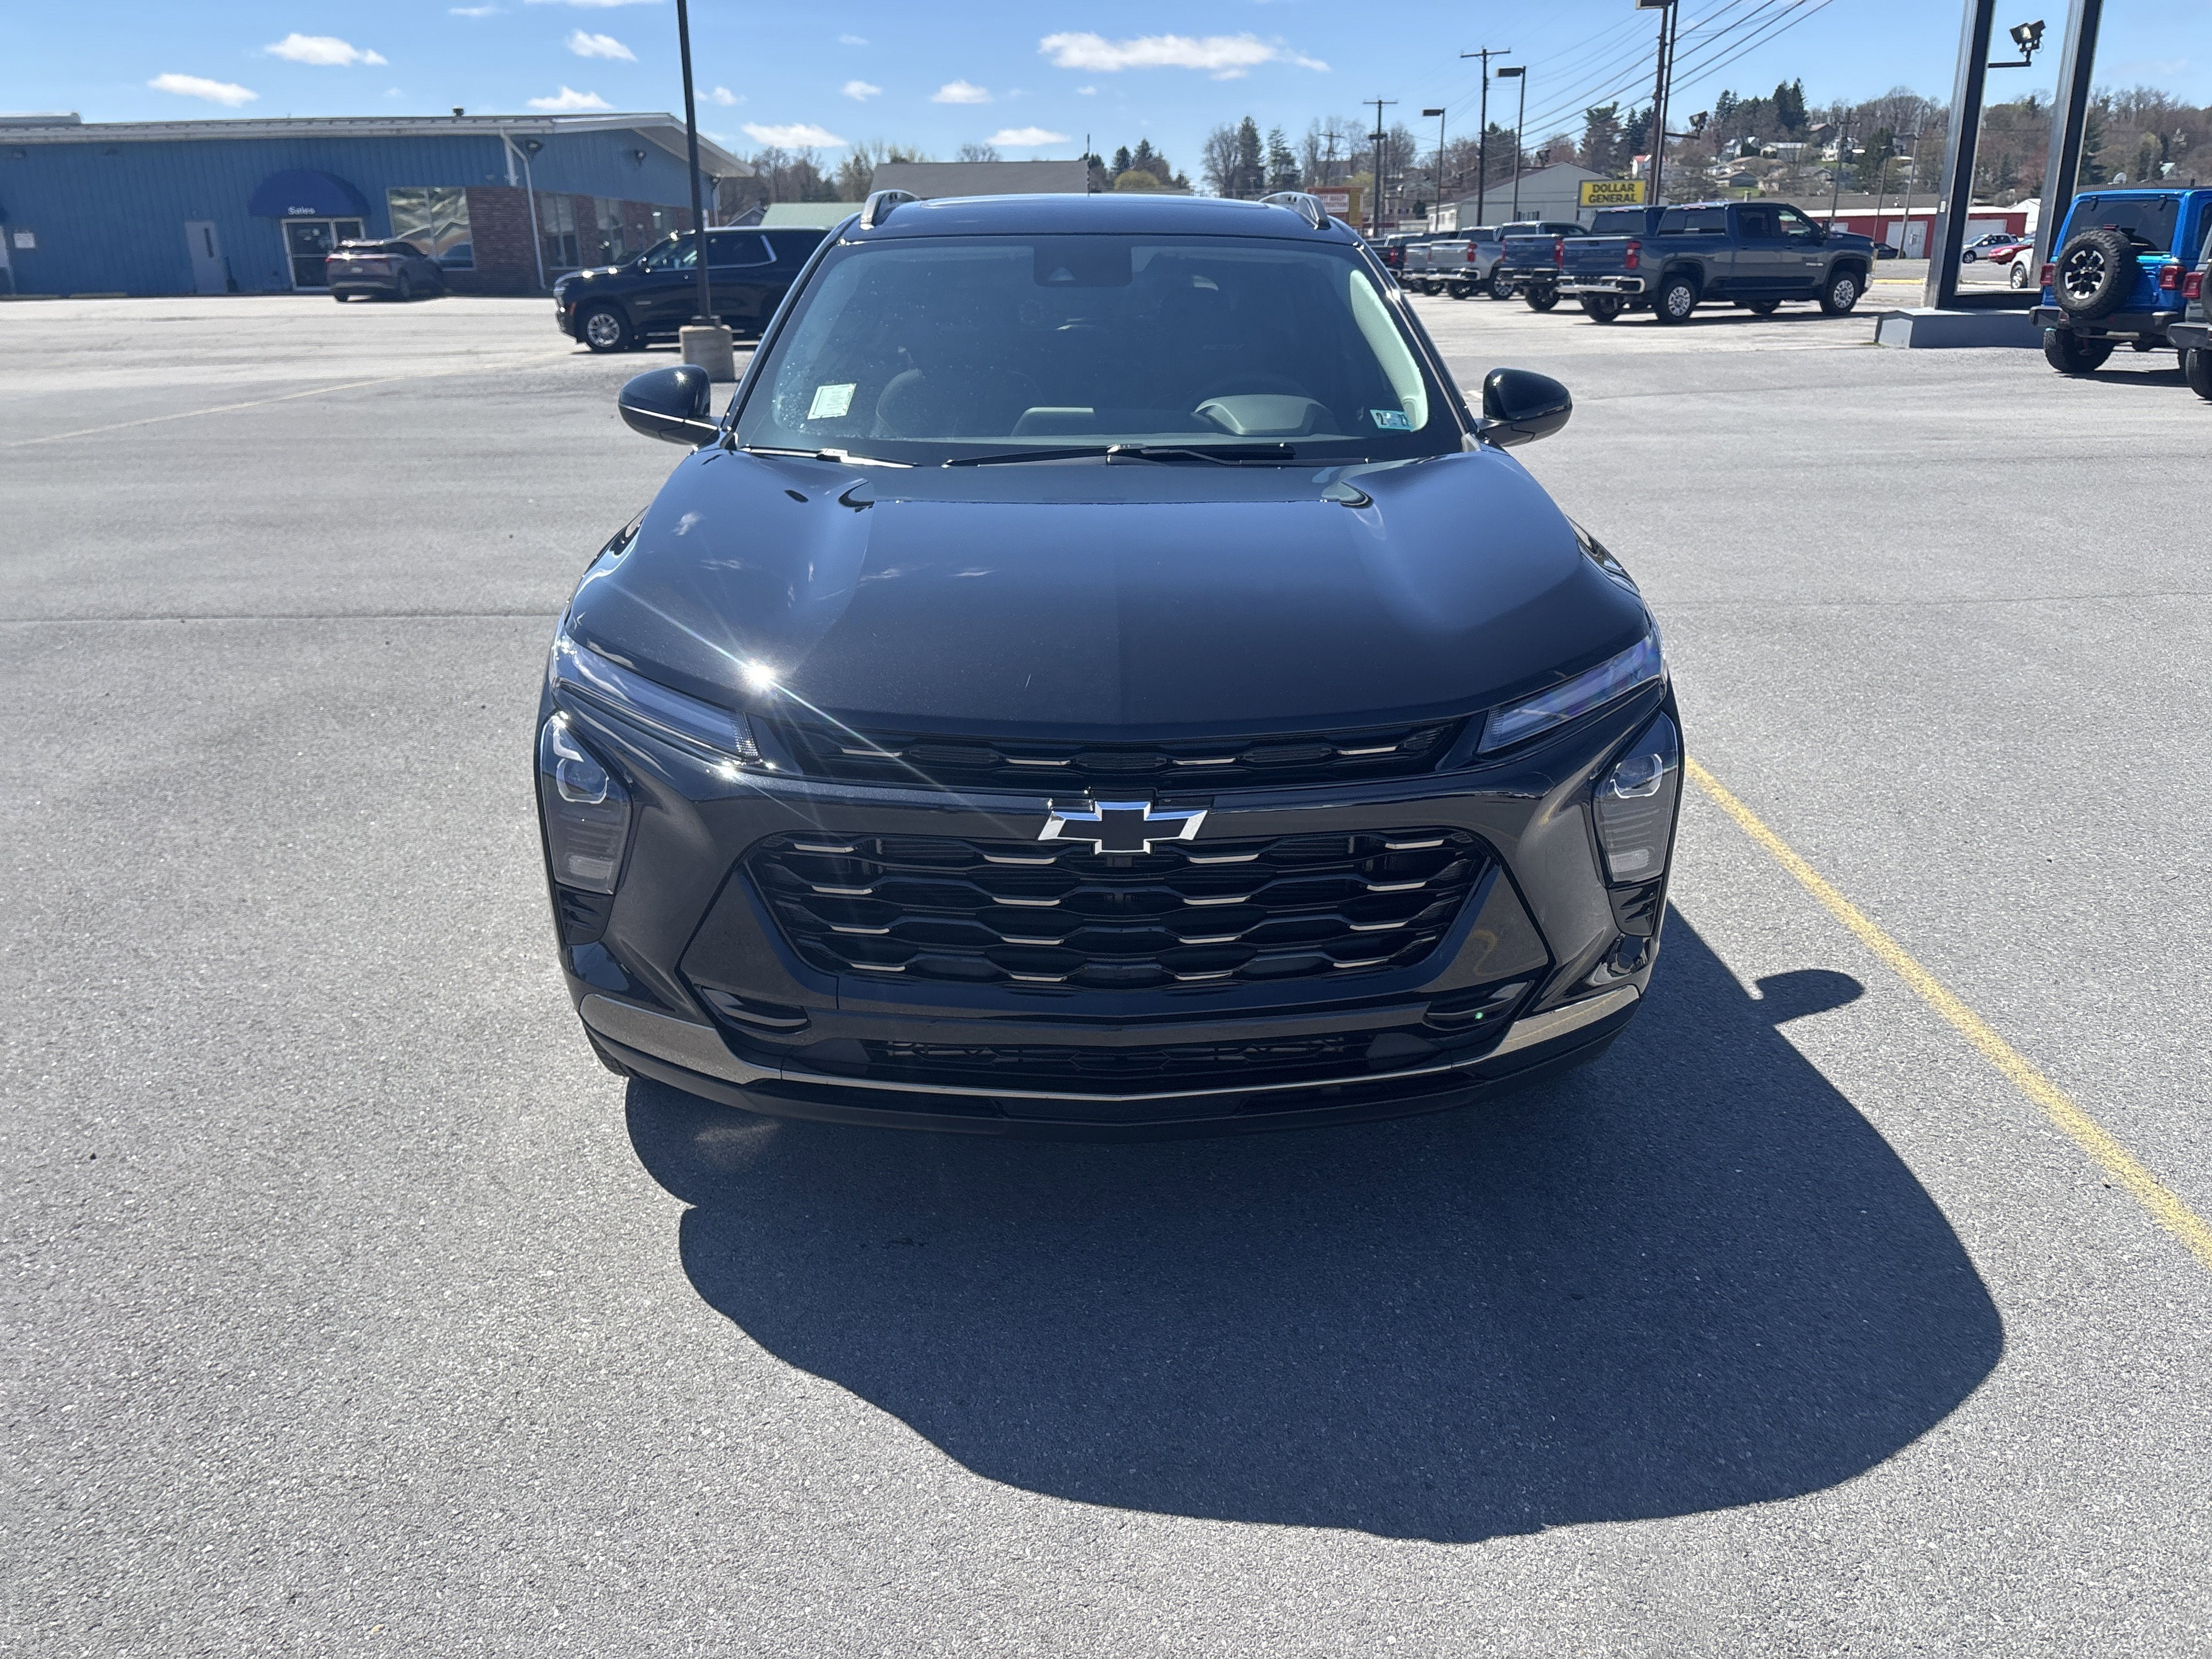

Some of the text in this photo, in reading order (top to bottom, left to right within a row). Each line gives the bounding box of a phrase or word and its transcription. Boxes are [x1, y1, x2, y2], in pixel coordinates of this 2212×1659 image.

[1593, 183, 1635, 193] DOLLAR
[1589, 194, 1638, 203] GENERAL
[287, 206, 316, 215] Sales
